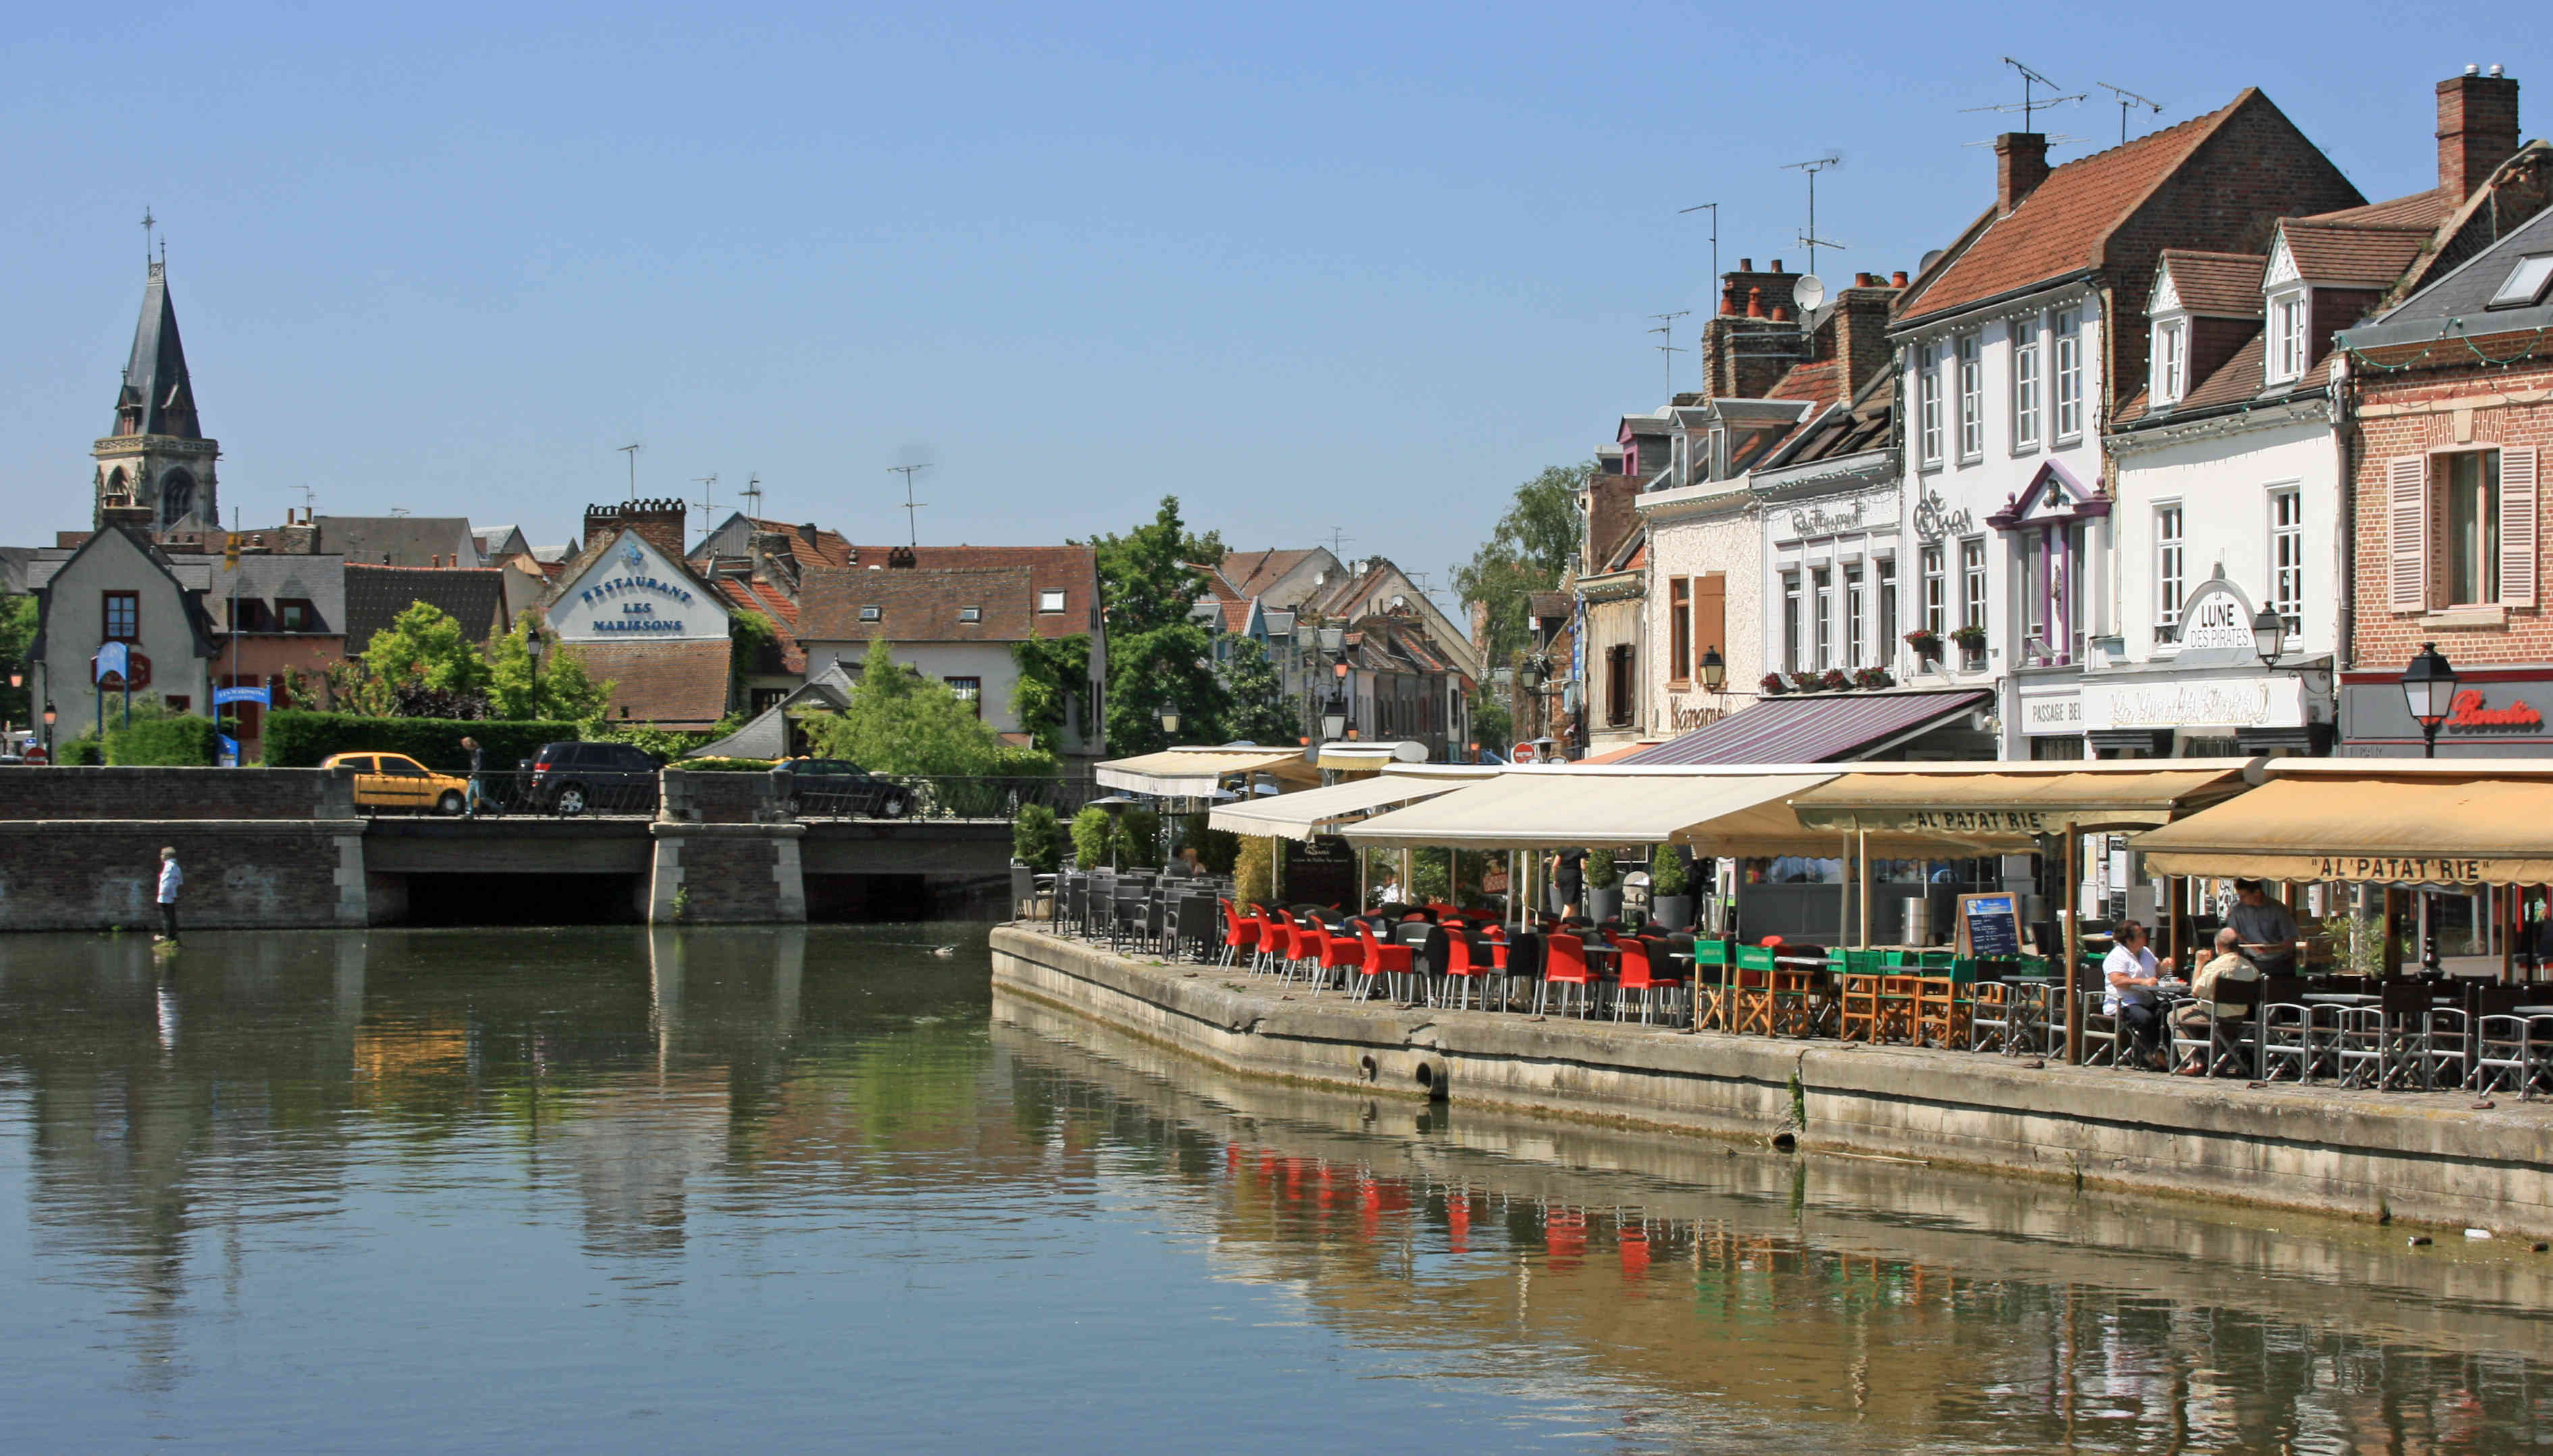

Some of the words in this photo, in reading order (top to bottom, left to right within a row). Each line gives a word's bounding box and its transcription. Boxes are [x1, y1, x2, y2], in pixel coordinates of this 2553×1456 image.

[581, 576, 691, 603] RESTAURANT
[623, 603, 652, 614] LES
[2201, 603, 2234, 627] LUNE
[593, 620, 683, 631] MARISSONS
[2190, 629, 2209, 648] DES
[2211, 628, 2248, 647] PIRATES
[2032, 703, 2063, 723] PASSAGE
